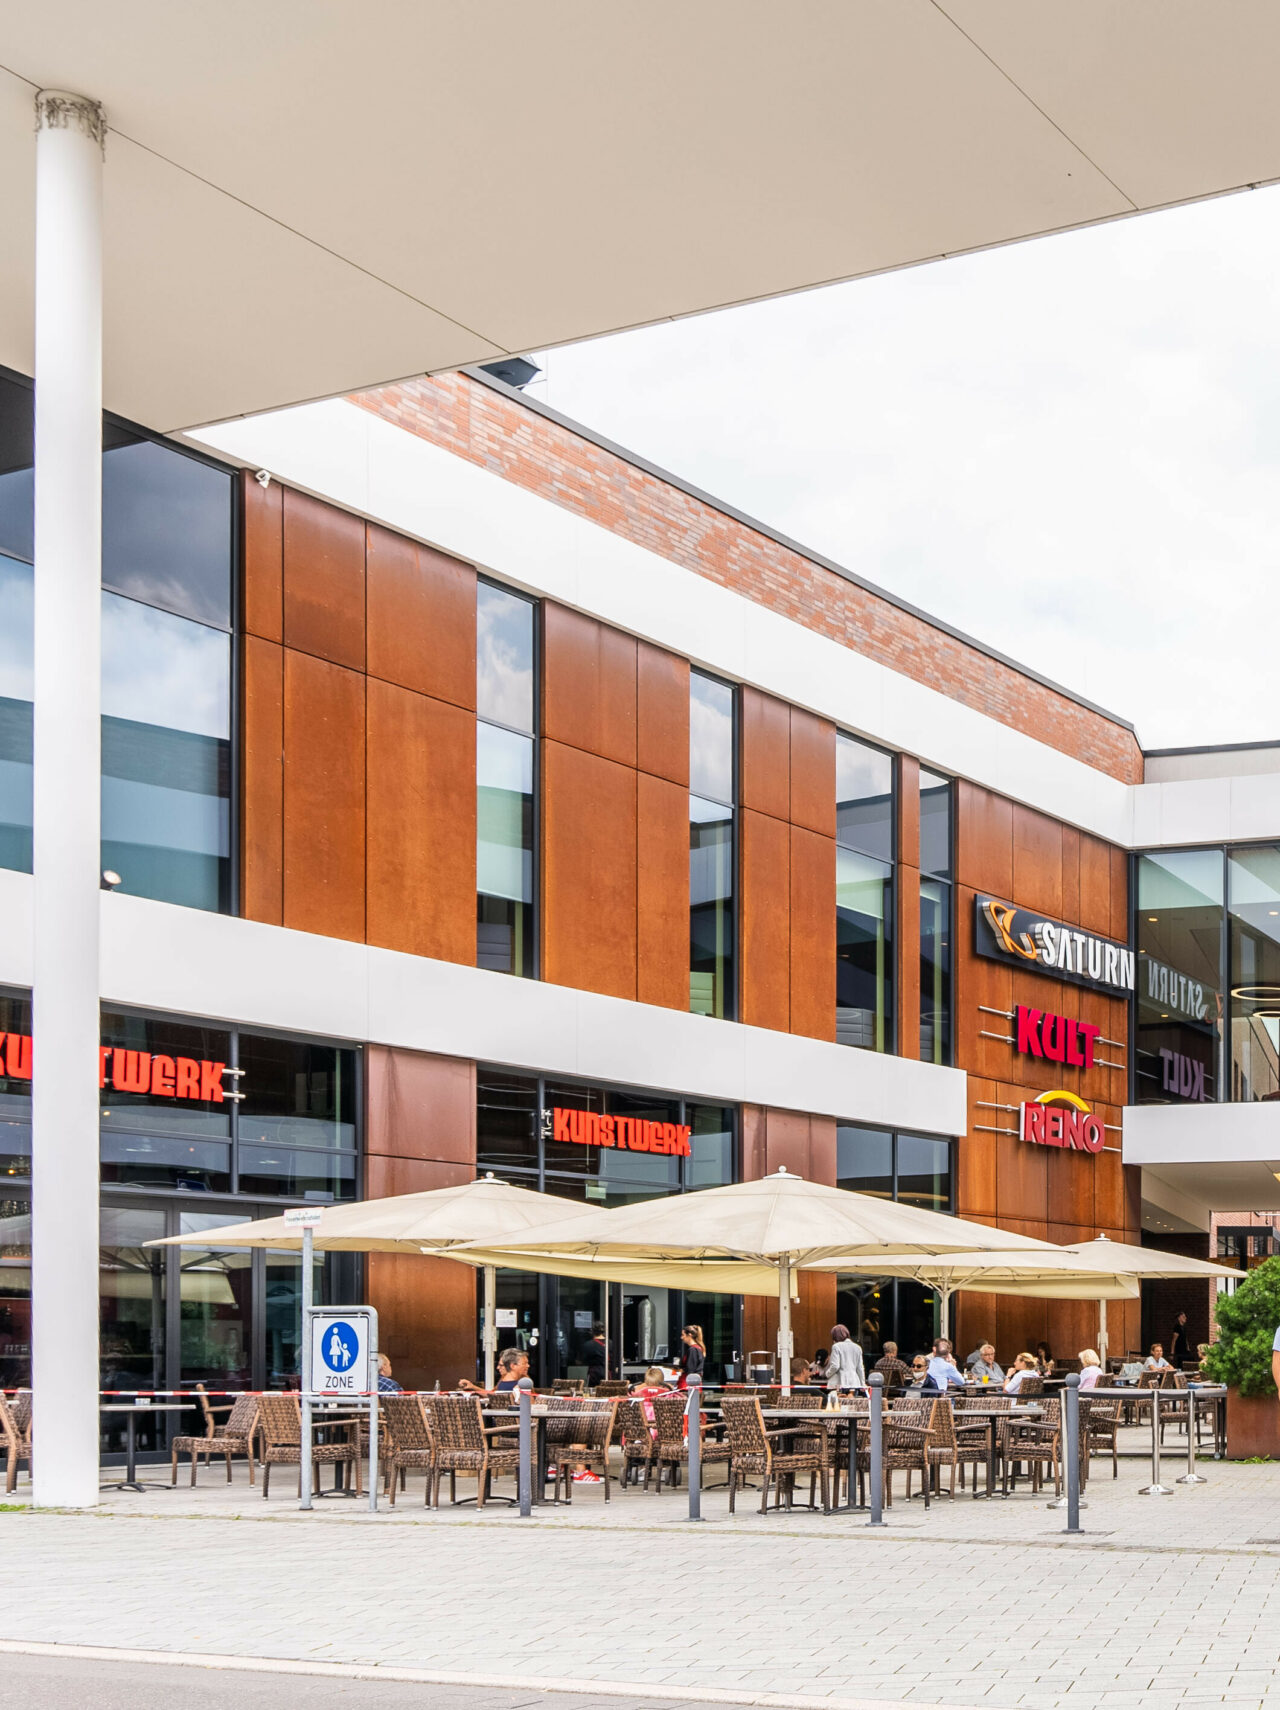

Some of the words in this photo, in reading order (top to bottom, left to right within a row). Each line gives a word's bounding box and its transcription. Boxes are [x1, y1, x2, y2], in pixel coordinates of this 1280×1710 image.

[1036, 921, 1135, 991] SATURN
[1016, 1005, 1100, 1069] KULT
[553, 1107, 691, 1157] KUNSTWERK
[1020, 1101, 1105, 1154] RENO
[325, 1376, 354, 1389] ZONE
